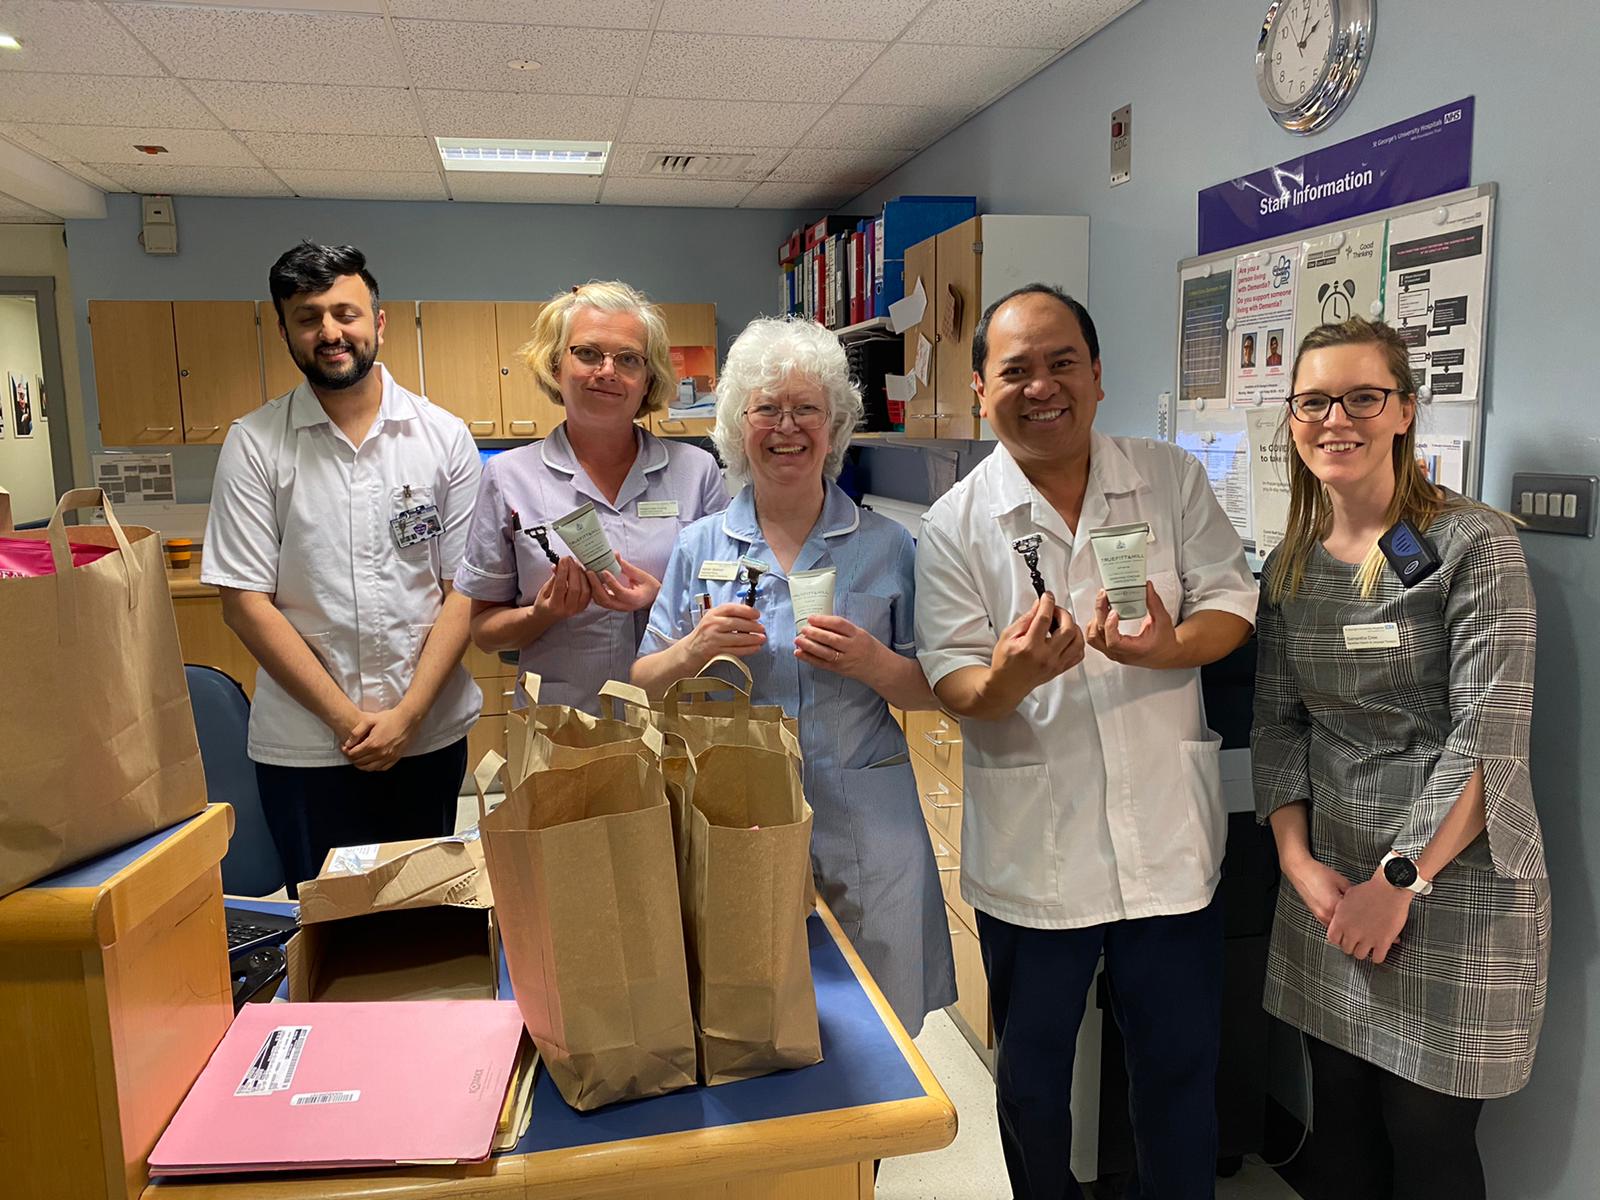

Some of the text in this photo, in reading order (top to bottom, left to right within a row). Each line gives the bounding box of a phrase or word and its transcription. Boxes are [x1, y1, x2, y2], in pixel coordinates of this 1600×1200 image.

[1291, 7, 1298, 20] 11
[1324, 4, 1329, 18] 2
[1281, 26, 1289, 40] 10
[1275, 52, 1282, 65] 9
[1279, 71, 1285, 83] 8
[1288, 80, 1293, 93] 7
[1300, 81, 1306, 94] 6
[1444, 110, 1461, 123] NHS
[1397, 127, 1420, 139] University
[1420, 119, 1442, 132] Hospitals
[1260, 170, 1373, 215] Staff Information
[1360, 241, 1374, 250] Good
[1353, 249, 1374, 258] Thinking
[1247, 266, 1256, 274] you
[1238, 273, 1266, 284] person living
[1247, 281, 1270, 291] Dementia?
[1252, 293, 1270, 302] support
[1270, 289, 1292, 298] someone
[1259, 300, 1282, 310] Dementia?
[1260, 444, 1267, 452] Is
